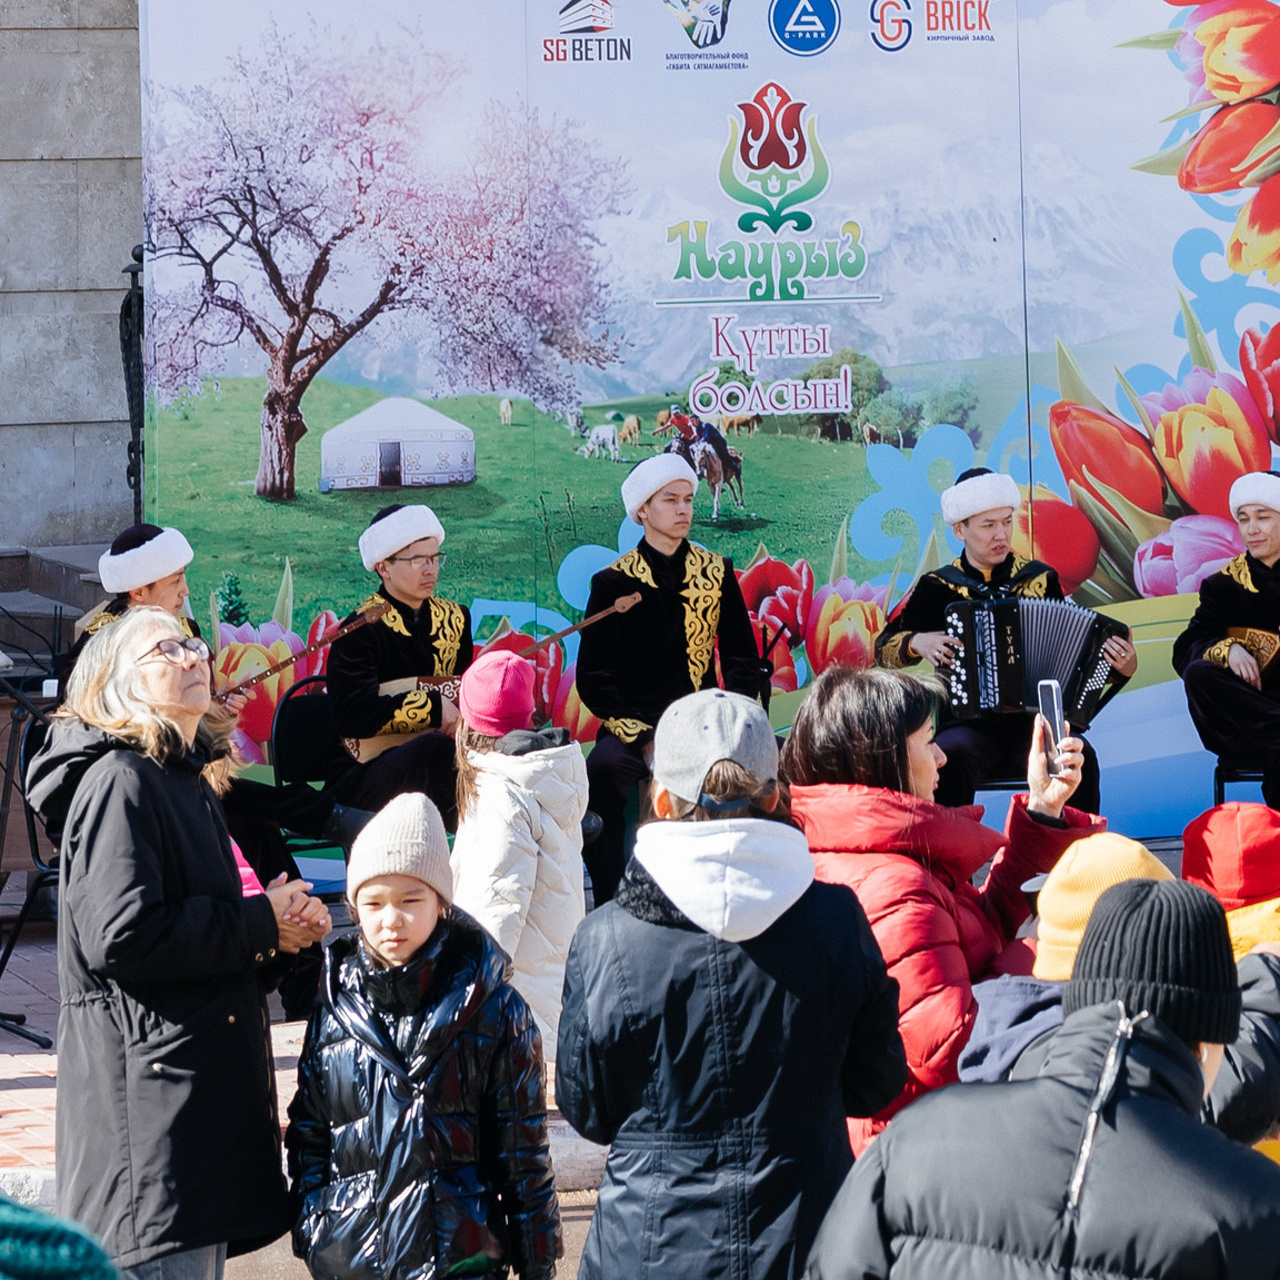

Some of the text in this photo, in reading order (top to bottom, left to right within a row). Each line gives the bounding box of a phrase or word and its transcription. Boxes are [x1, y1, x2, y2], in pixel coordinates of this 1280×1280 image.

[926, 0, 991, 31] BRICK
[543, 37, 631, 61] SG BETON
[926, 33, 996, 42] КИРПИЧНЫЙ ЗАВОД
[665, 51, 749, 60] БЛАГОТВОРИТЕЛЬНЫЙ ФОНД
[667, 220, 866, 300] Наурыз
[691, 368, 851, 414] болсын!
